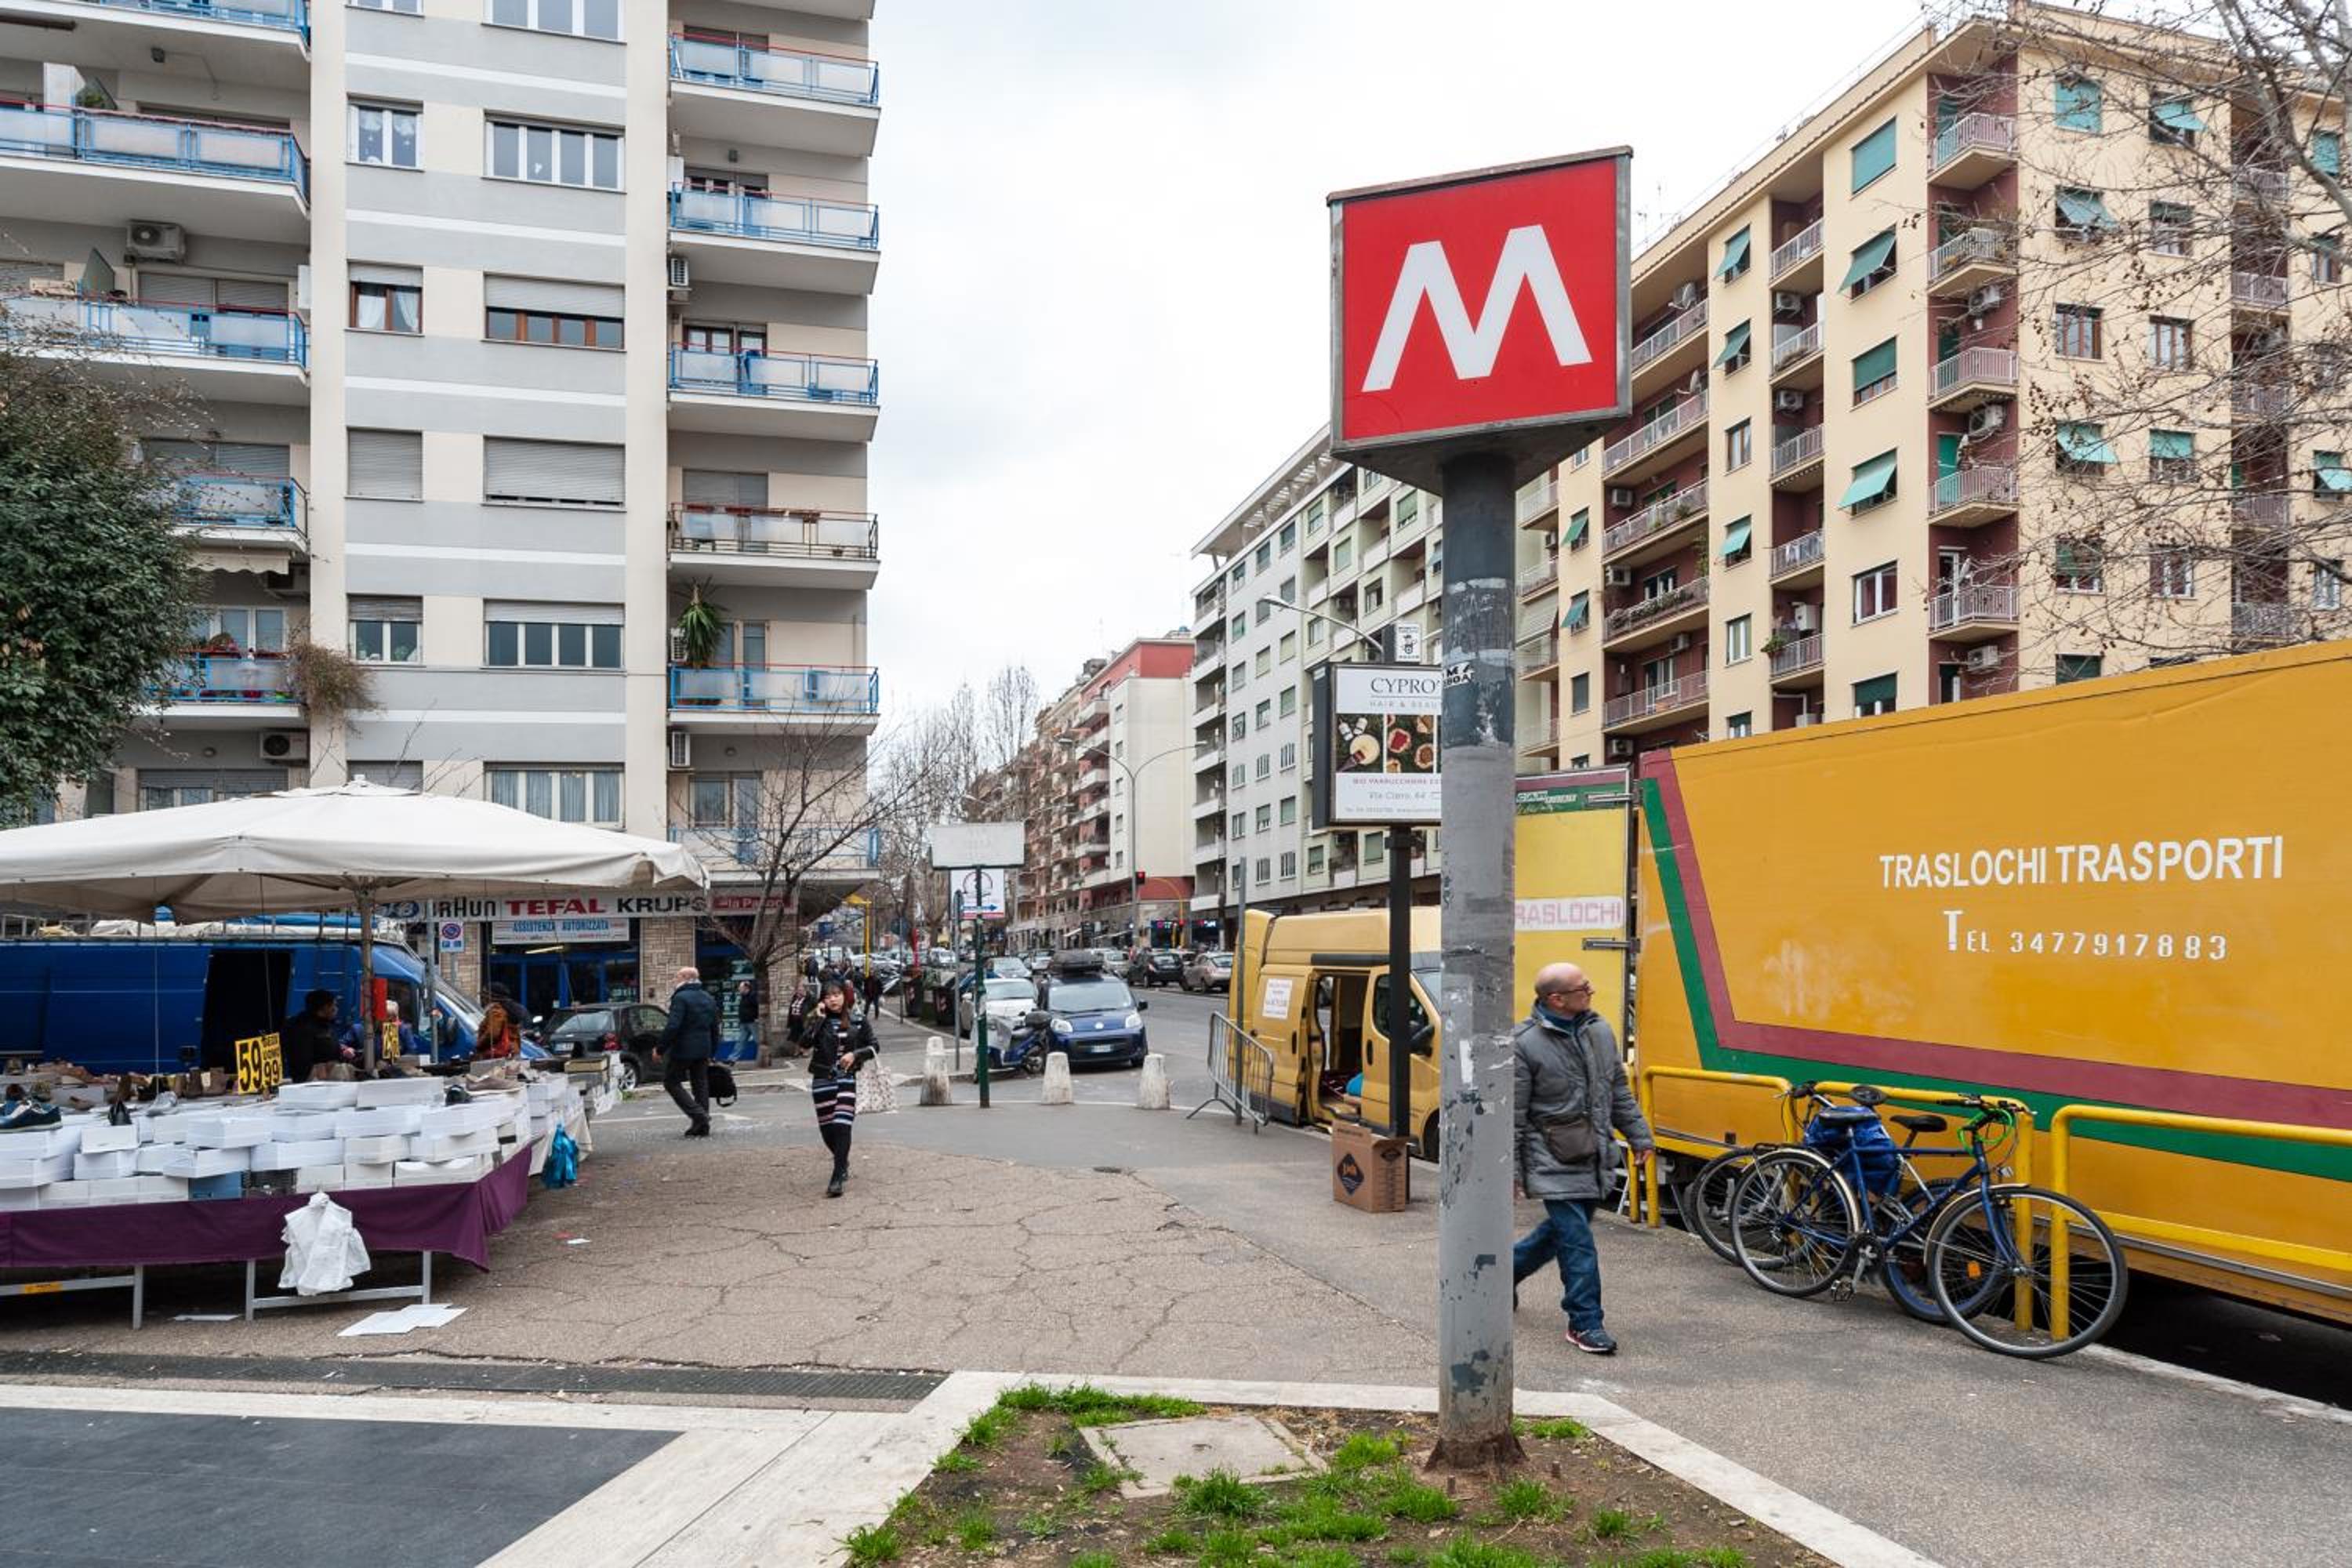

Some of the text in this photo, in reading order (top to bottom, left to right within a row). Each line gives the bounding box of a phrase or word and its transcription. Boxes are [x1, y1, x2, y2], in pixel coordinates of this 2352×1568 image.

[1362, 224, 1593, 392] M
[1370, 677, 1441, 694] CYPRO'
[1879, 836, 2283, 887] TRASLOCHI TRASPORTI
[505, 898, 608, 916] TEFAL
[617, 897, 704, 913] KRUPS
[1514, 902, 1621, 924] RASLOCHI
[514, 920, 609, 932] ASSISTENZA AUTORIZZATA
[2009, 931, 2227, 960] 3477917883
[239, 1040, 280, 1092] 59 99
